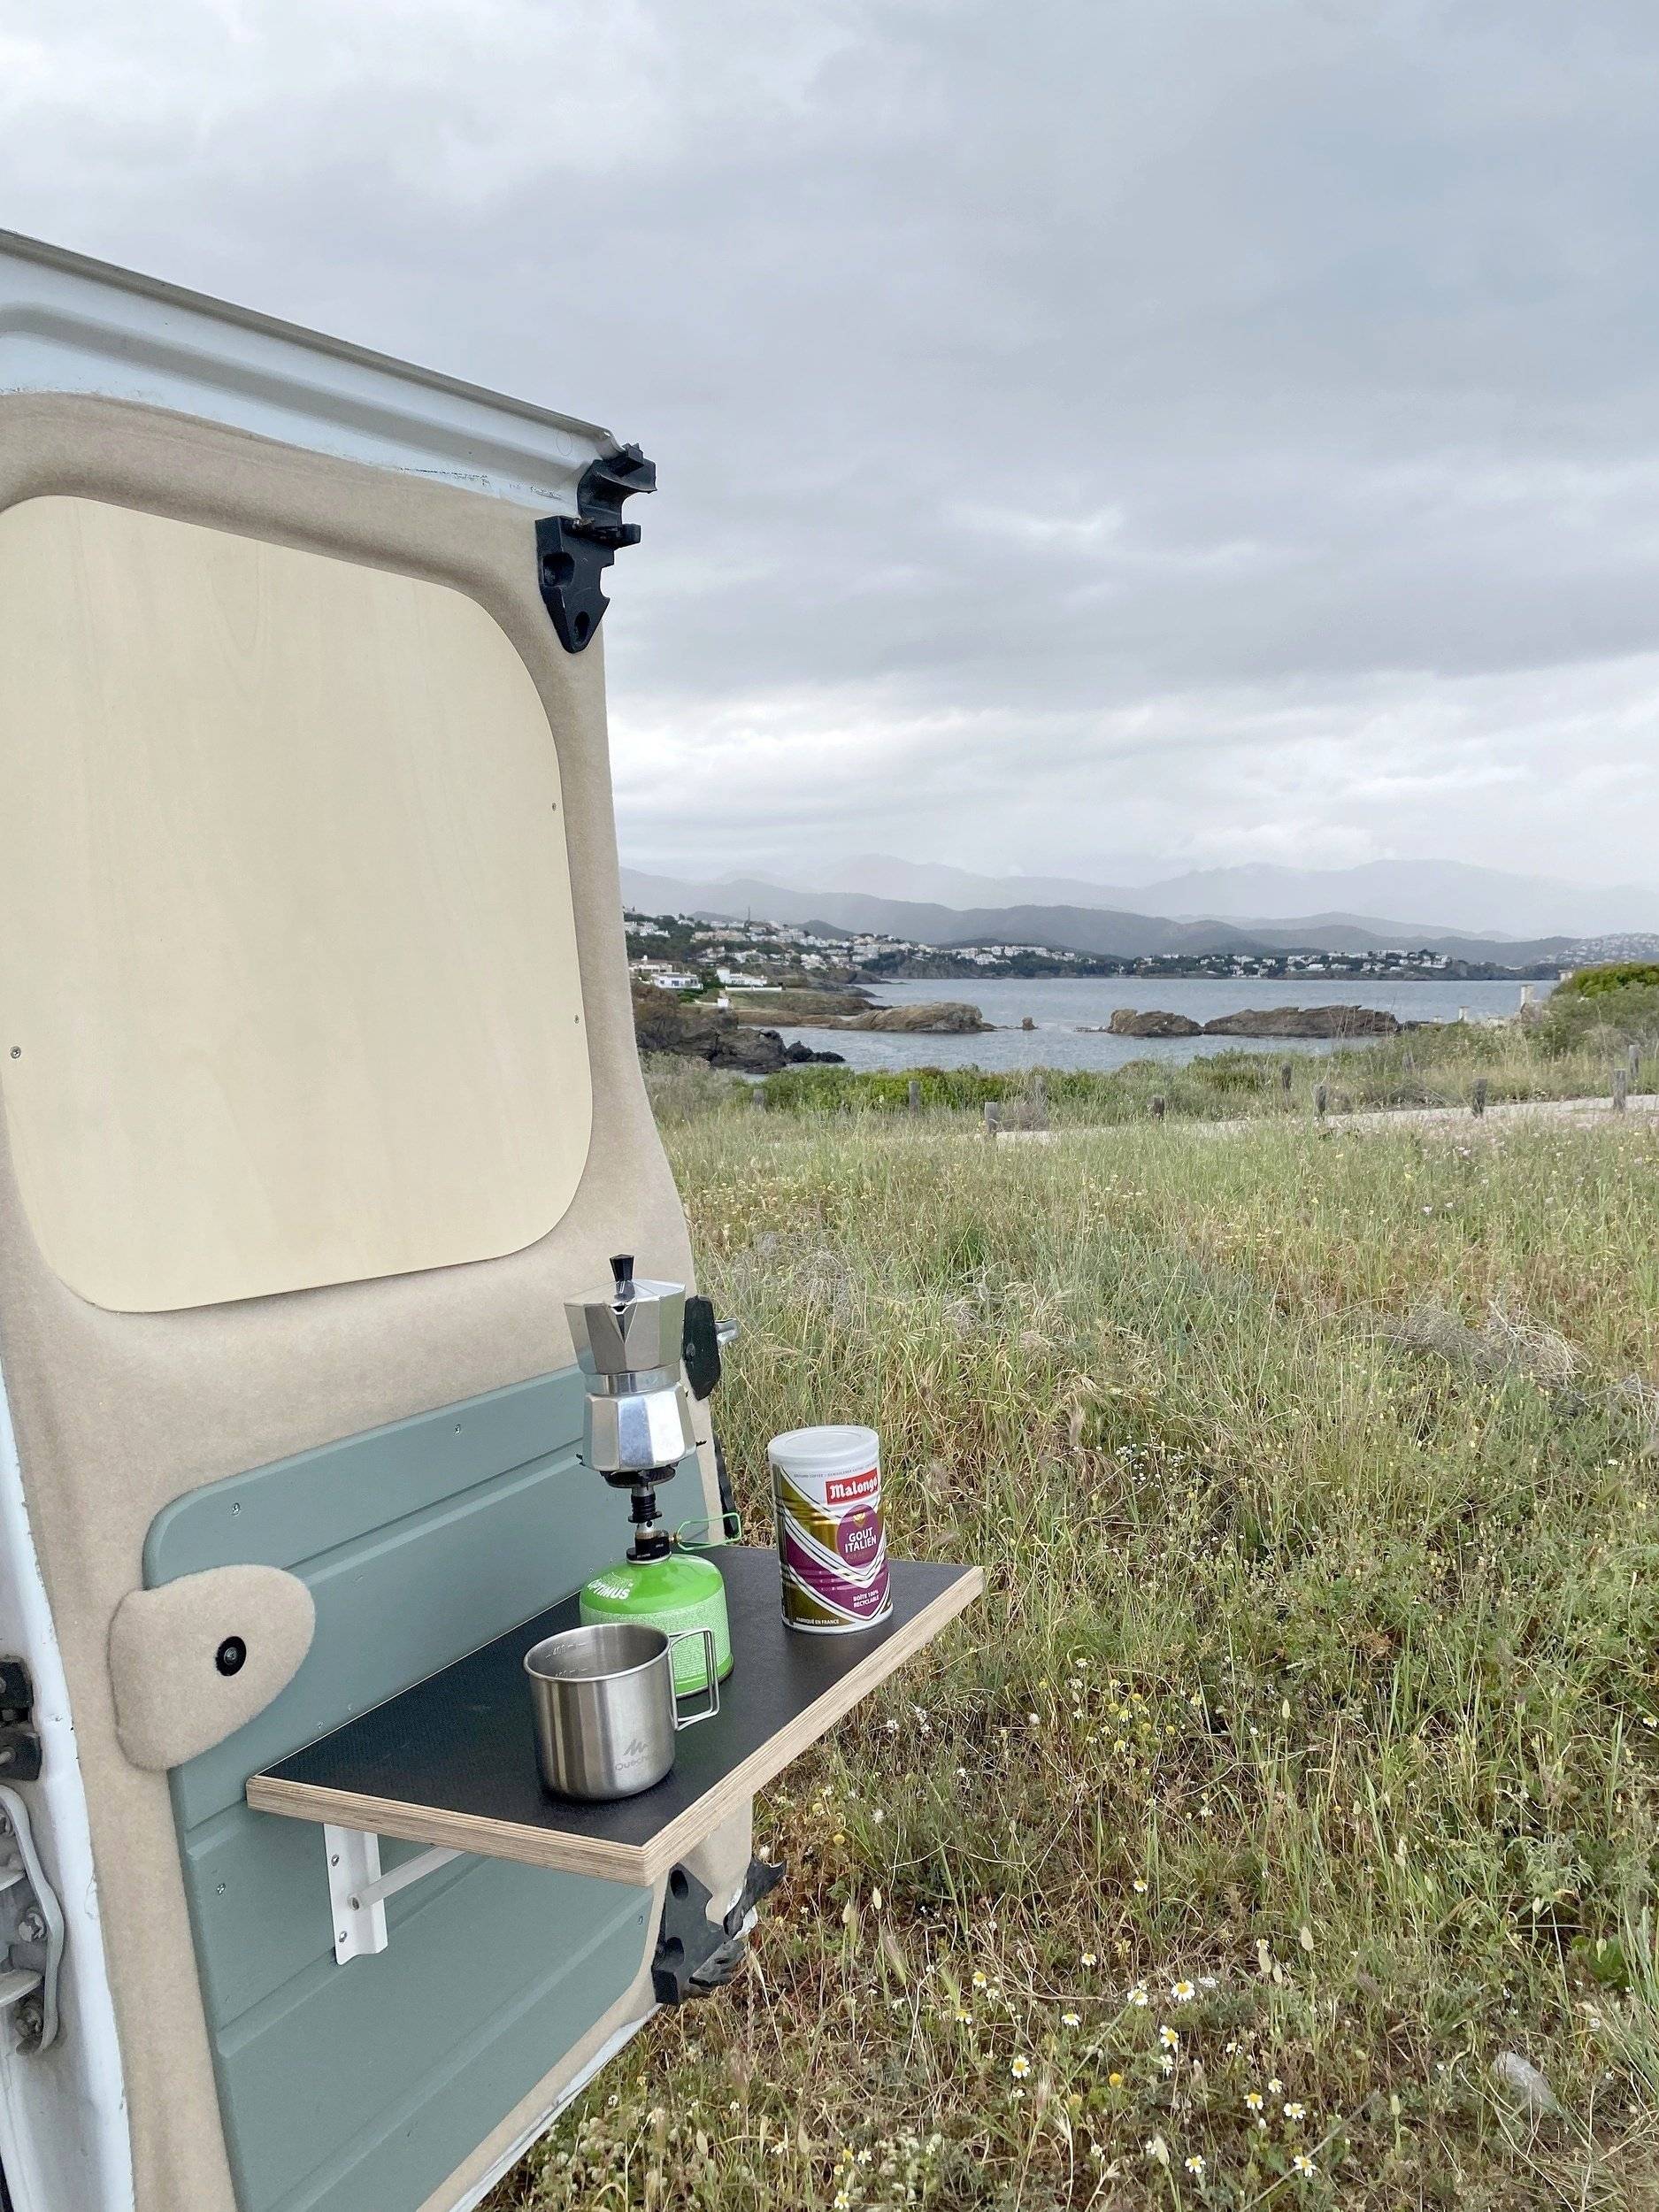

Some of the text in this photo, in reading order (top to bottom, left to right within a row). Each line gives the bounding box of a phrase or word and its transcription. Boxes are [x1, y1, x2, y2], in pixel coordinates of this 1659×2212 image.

[830, 1476, 878, 1500] Malongo
[844, 1534, 877, 1554] ITALIEN
[849, 1526, 873, 1543] GOUT
